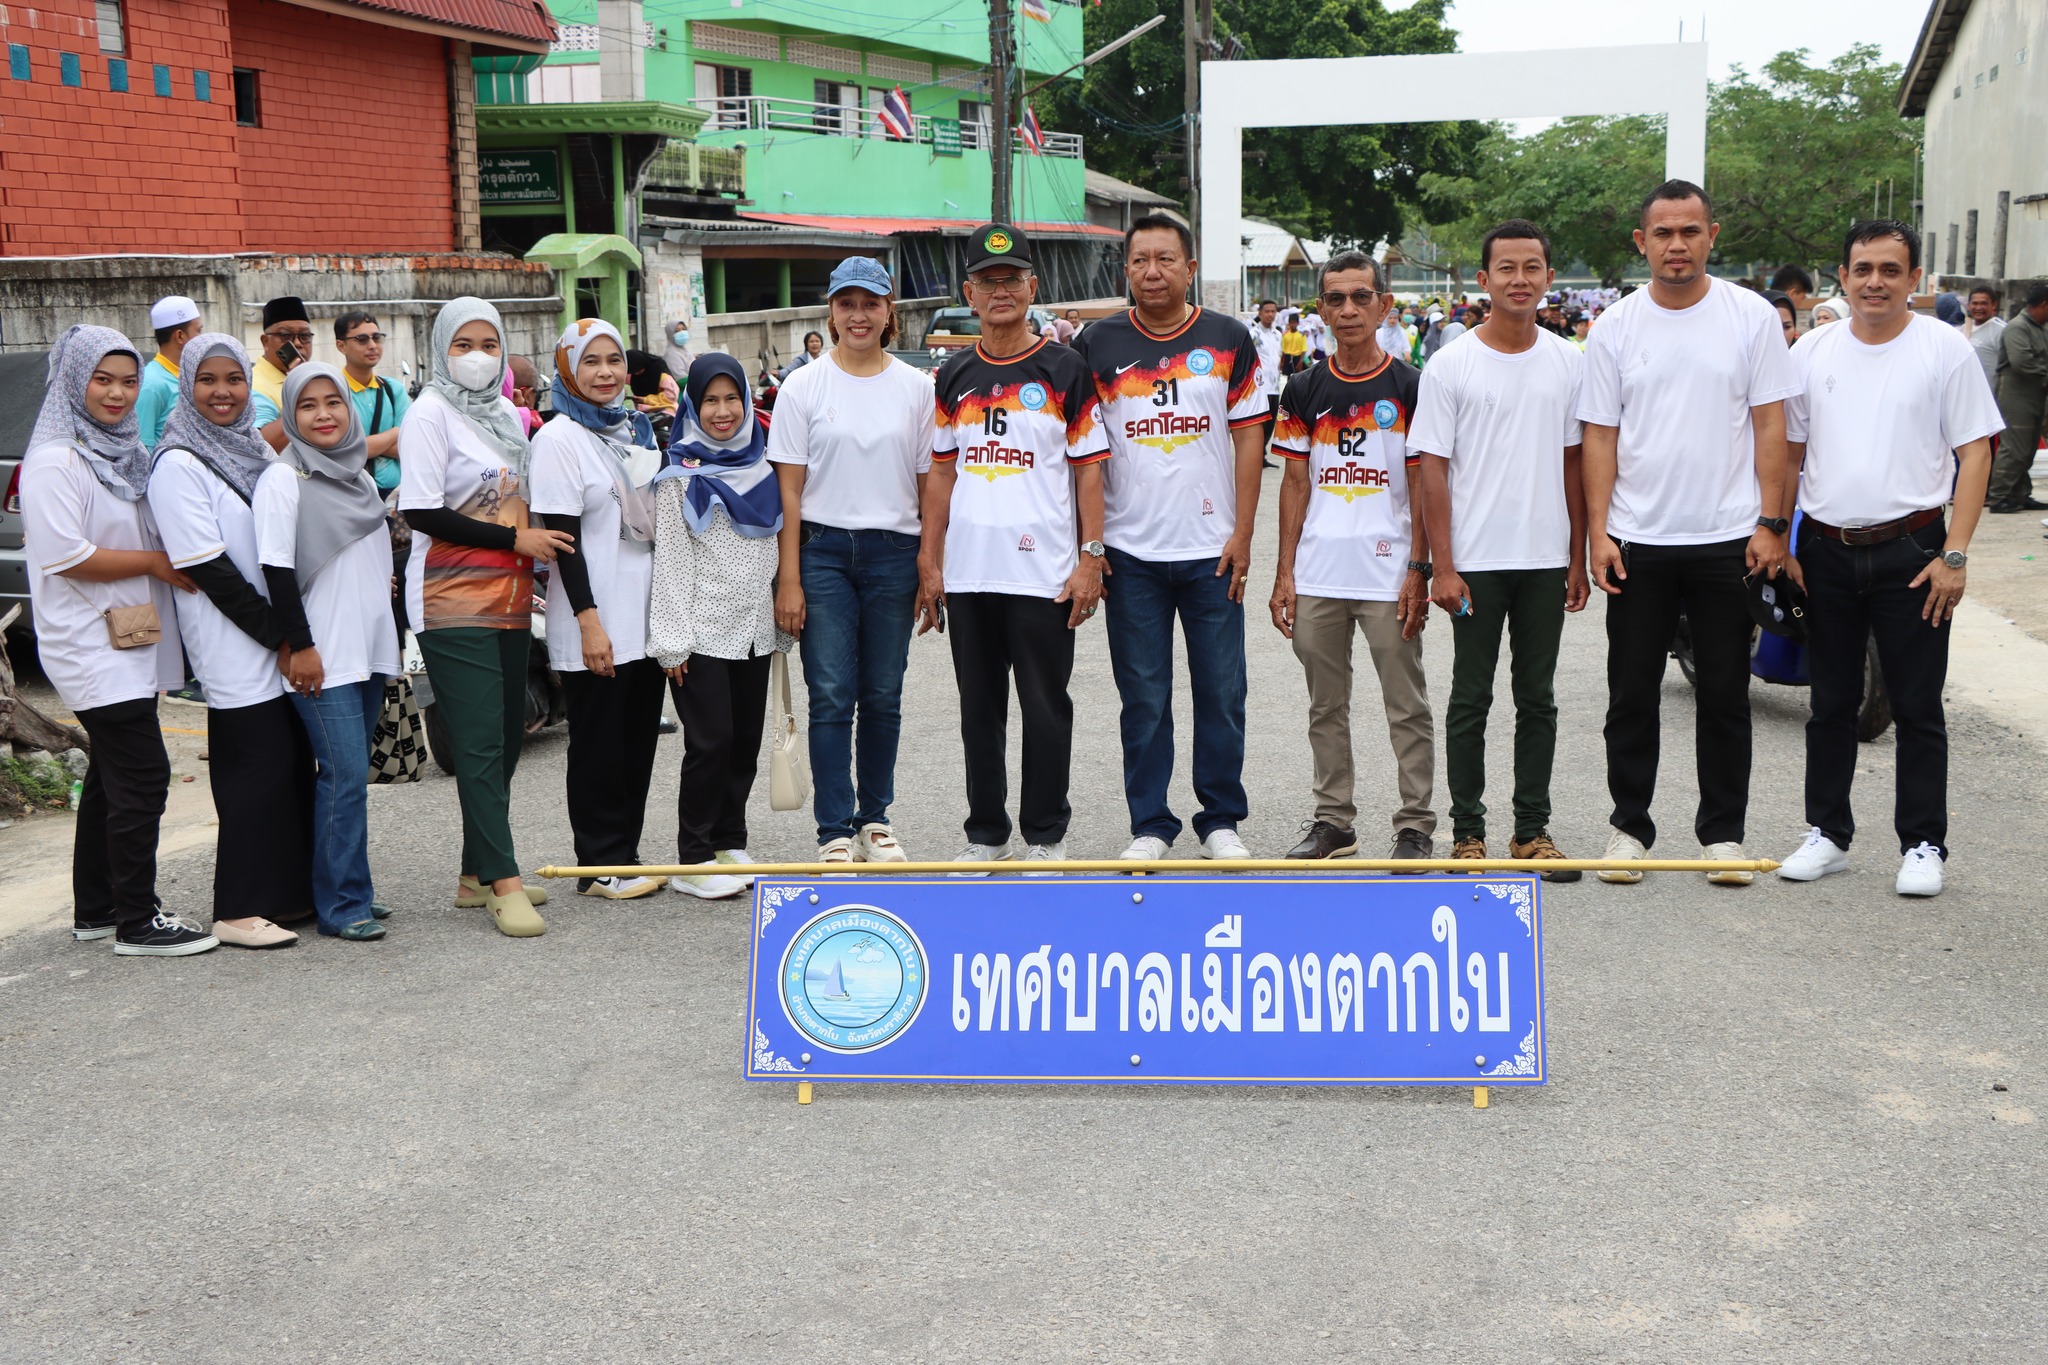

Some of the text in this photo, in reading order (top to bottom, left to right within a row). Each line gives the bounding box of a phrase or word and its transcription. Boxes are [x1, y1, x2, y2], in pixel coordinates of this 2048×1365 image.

[1152, 377, 1179, 407] 31
[982, 406, 1008, 437] 16
[965, 440, 1035, 469] ANTARA
[1338, 427, 1367, 457] 62
[794, 914, 916, 969] เทศบาลเมืองตากใบ
[951, 905, 1511, 1032] เทศบาลเมืองตากใบ
[792, 994, 914, 1042] อำเภอตากใบ จังหวัดนราธิวาส
